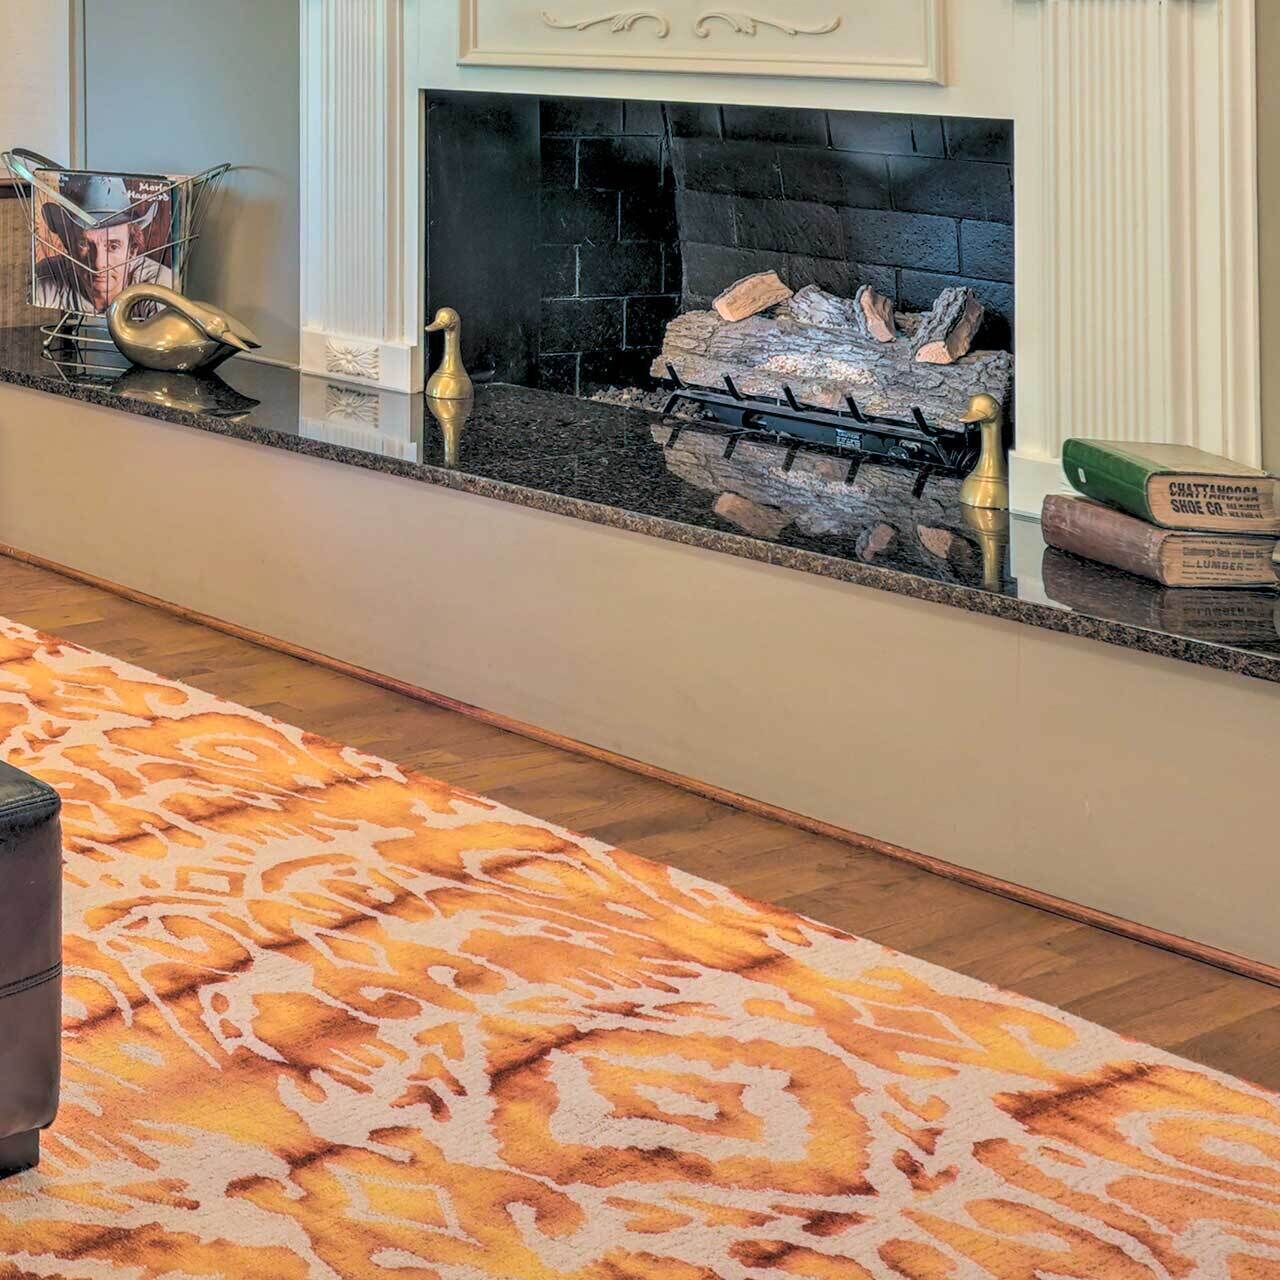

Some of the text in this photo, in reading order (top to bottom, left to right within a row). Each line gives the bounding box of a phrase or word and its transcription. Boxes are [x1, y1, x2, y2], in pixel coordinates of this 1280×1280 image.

[1169, 482, 1259, 502] CHATTANOOGA
[1170, 499, 1205, 515] SHOE
[1196, 560, 1244, 571] LUMBER
